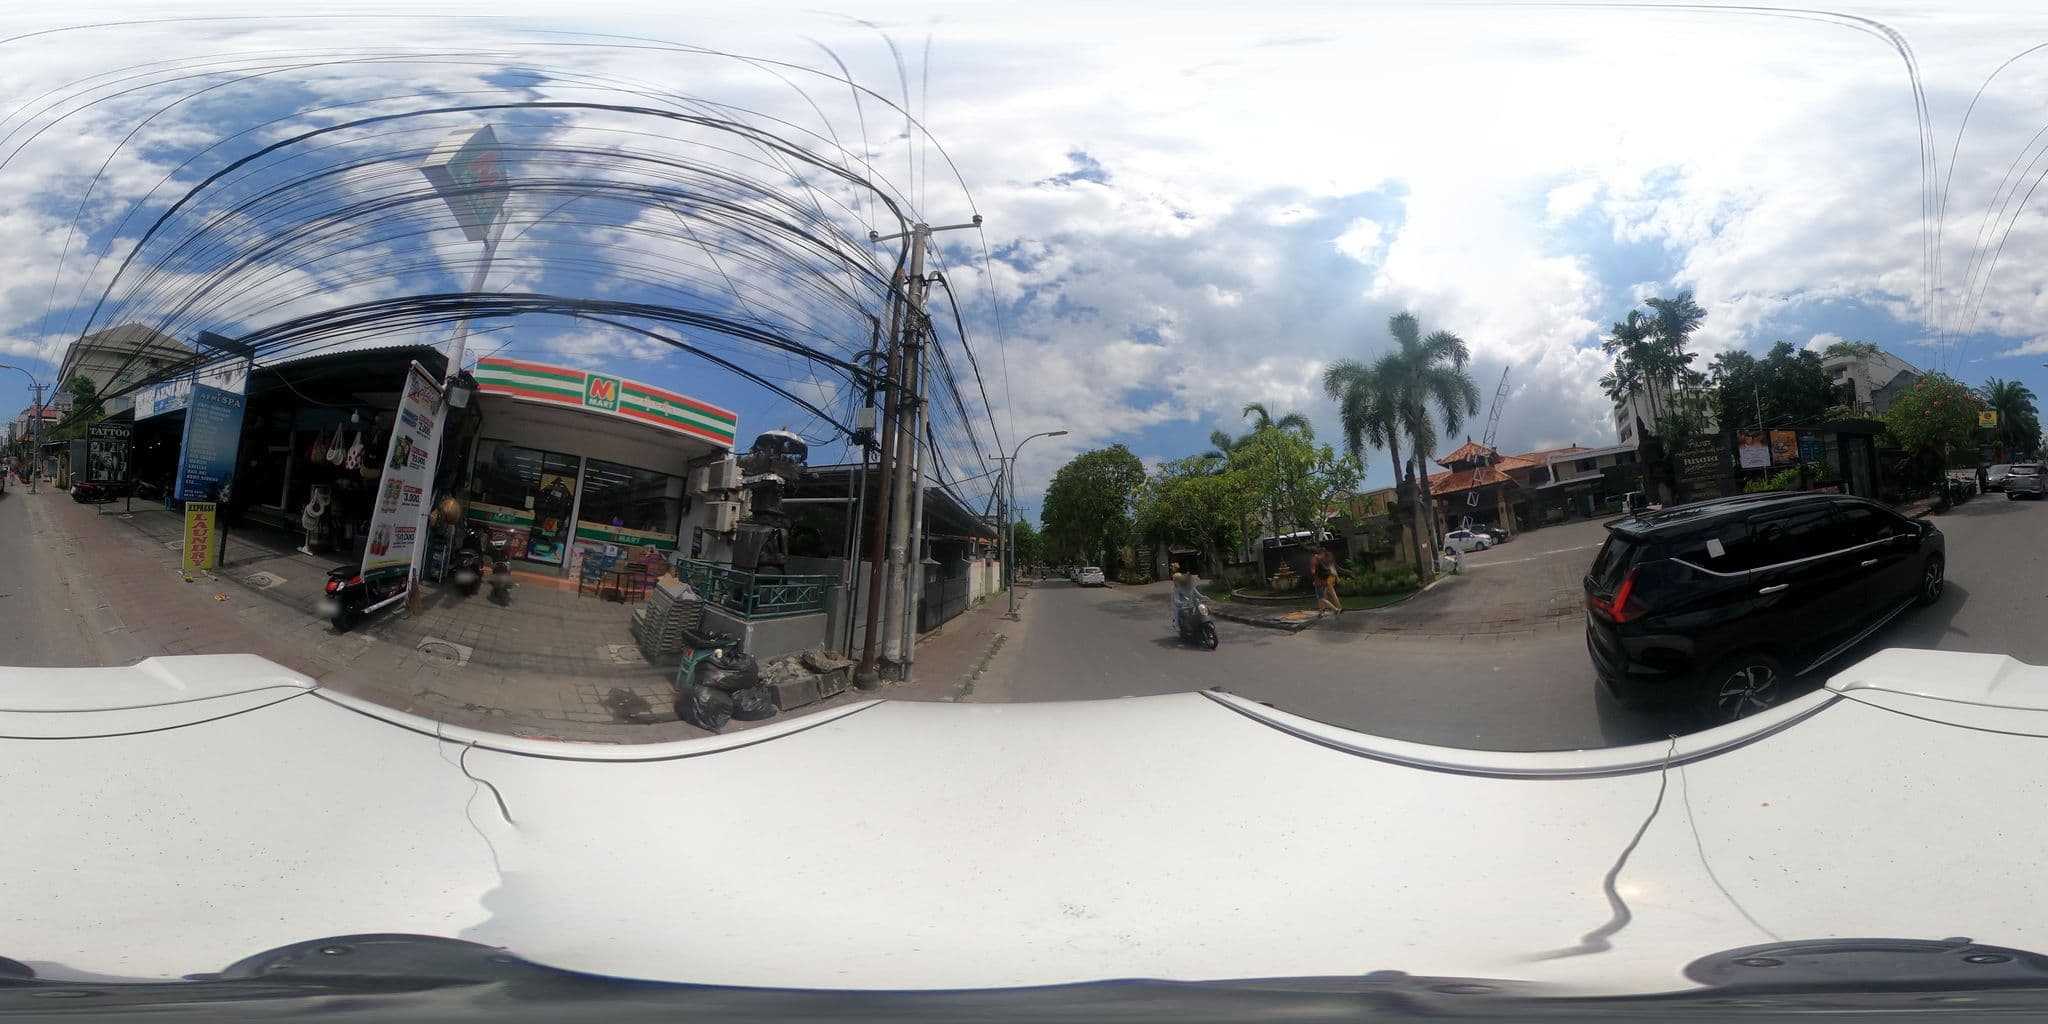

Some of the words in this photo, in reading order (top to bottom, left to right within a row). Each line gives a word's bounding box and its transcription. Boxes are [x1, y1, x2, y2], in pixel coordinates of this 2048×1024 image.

[222, 396, 241, 408] SPA
[588, 398, 614, 408] MART
[90, 427, 130, 437] TATTOO
[188, 504, 215, 512] EXPRESS
[191, 513, 209, 567] LAUNDRY
[618, 535, 640, 543] MART
